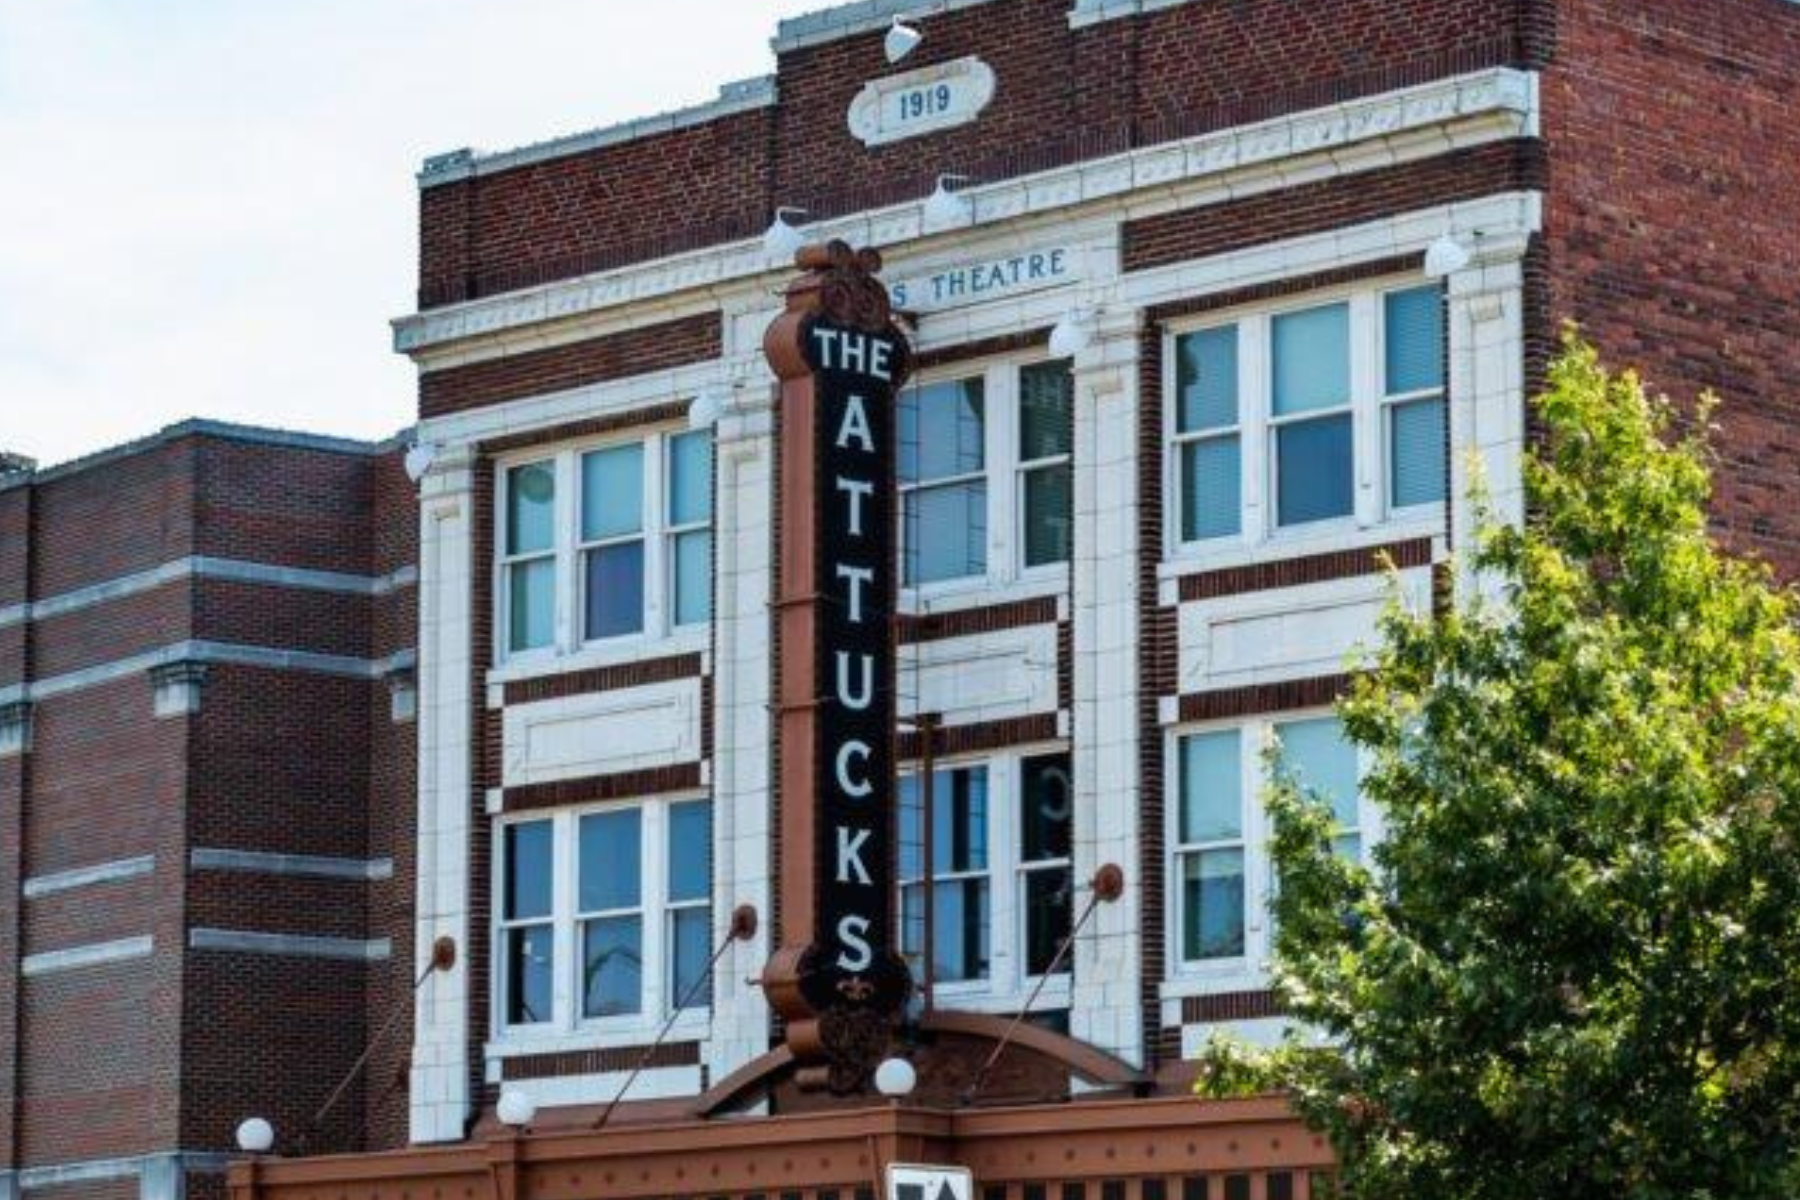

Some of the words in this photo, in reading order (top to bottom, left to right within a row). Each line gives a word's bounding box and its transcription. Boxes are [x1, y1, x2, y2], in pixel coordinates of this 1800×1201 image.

[900, 84, 949, 119] 1919
[932, 249, 1065, 299] THEATRE
[813, 328, 892, 379] THE
[836, 395, 874, 972] ATTUCKS
